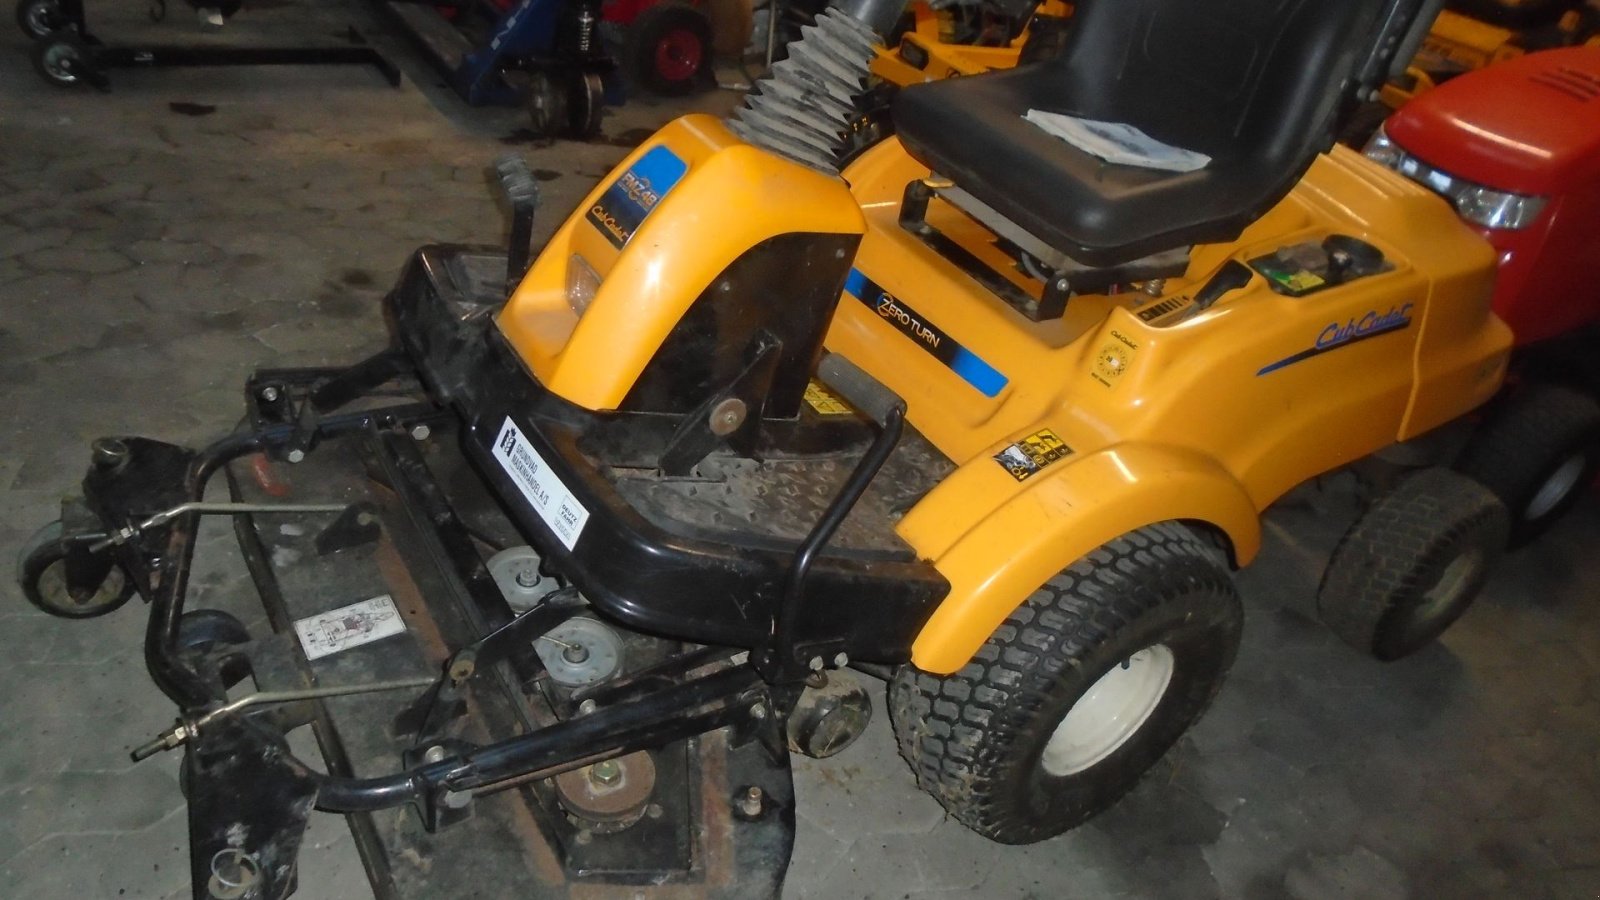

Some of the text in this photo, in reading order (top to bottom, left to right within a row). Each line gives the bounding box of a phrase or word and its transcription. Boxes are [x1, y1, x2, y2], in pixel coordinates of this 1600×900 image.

[592, 205, 629, 242] Cub Cadet
[877, 294, 940, 348] ZERO TURN
[1315, 303, 1414, 350] Cub Cadet
[511, 454, 541, 495] MASKINHANDEL
[539, 490, 550, 506] A/S
[560, 511, 575, 527] FAHR
[561, 504, 578, 522] DEUTZ
